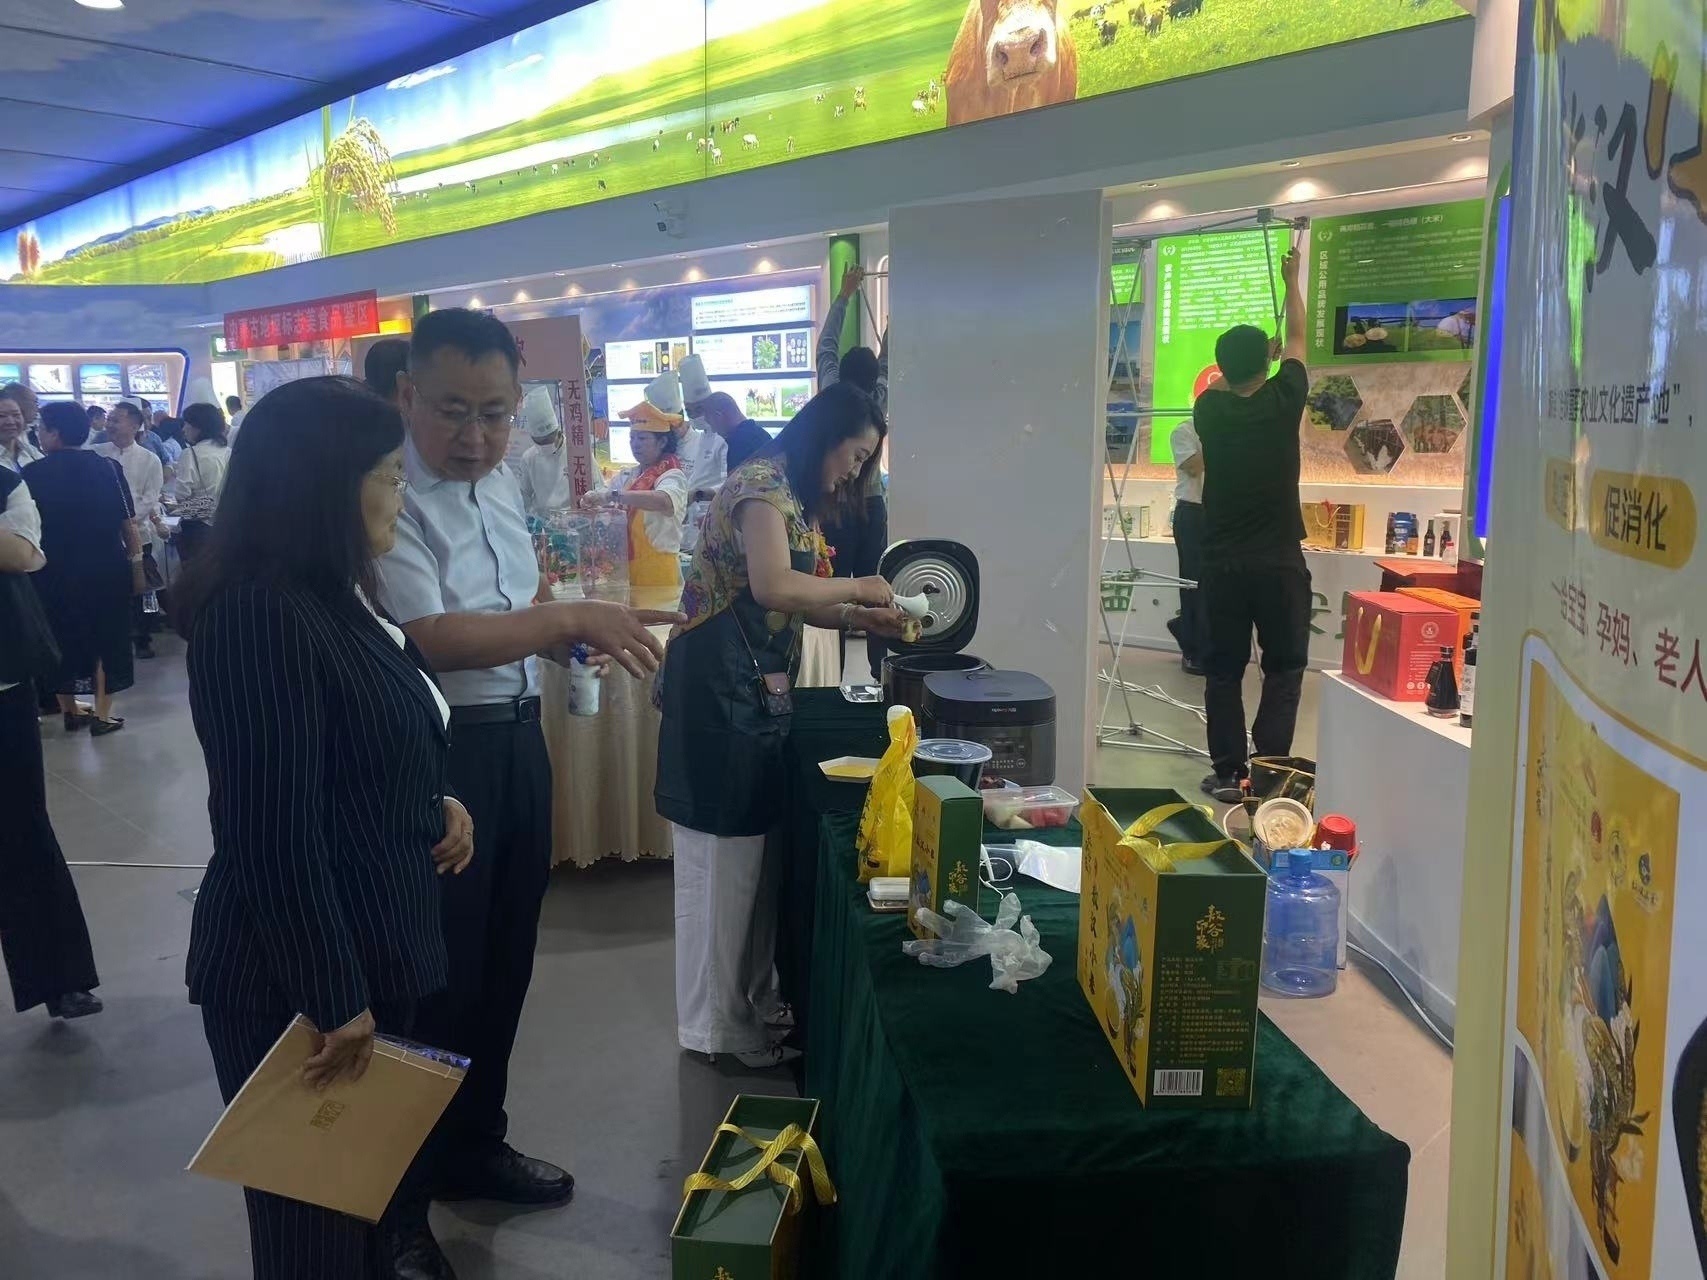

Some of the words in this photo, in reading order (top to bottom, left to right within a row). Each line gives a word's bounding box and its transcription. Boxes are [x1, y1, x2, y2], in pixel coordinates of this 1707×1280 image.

[567, 380, 584, 447] 无鸡精
[1603, 484, 1668, 551] 促消化
